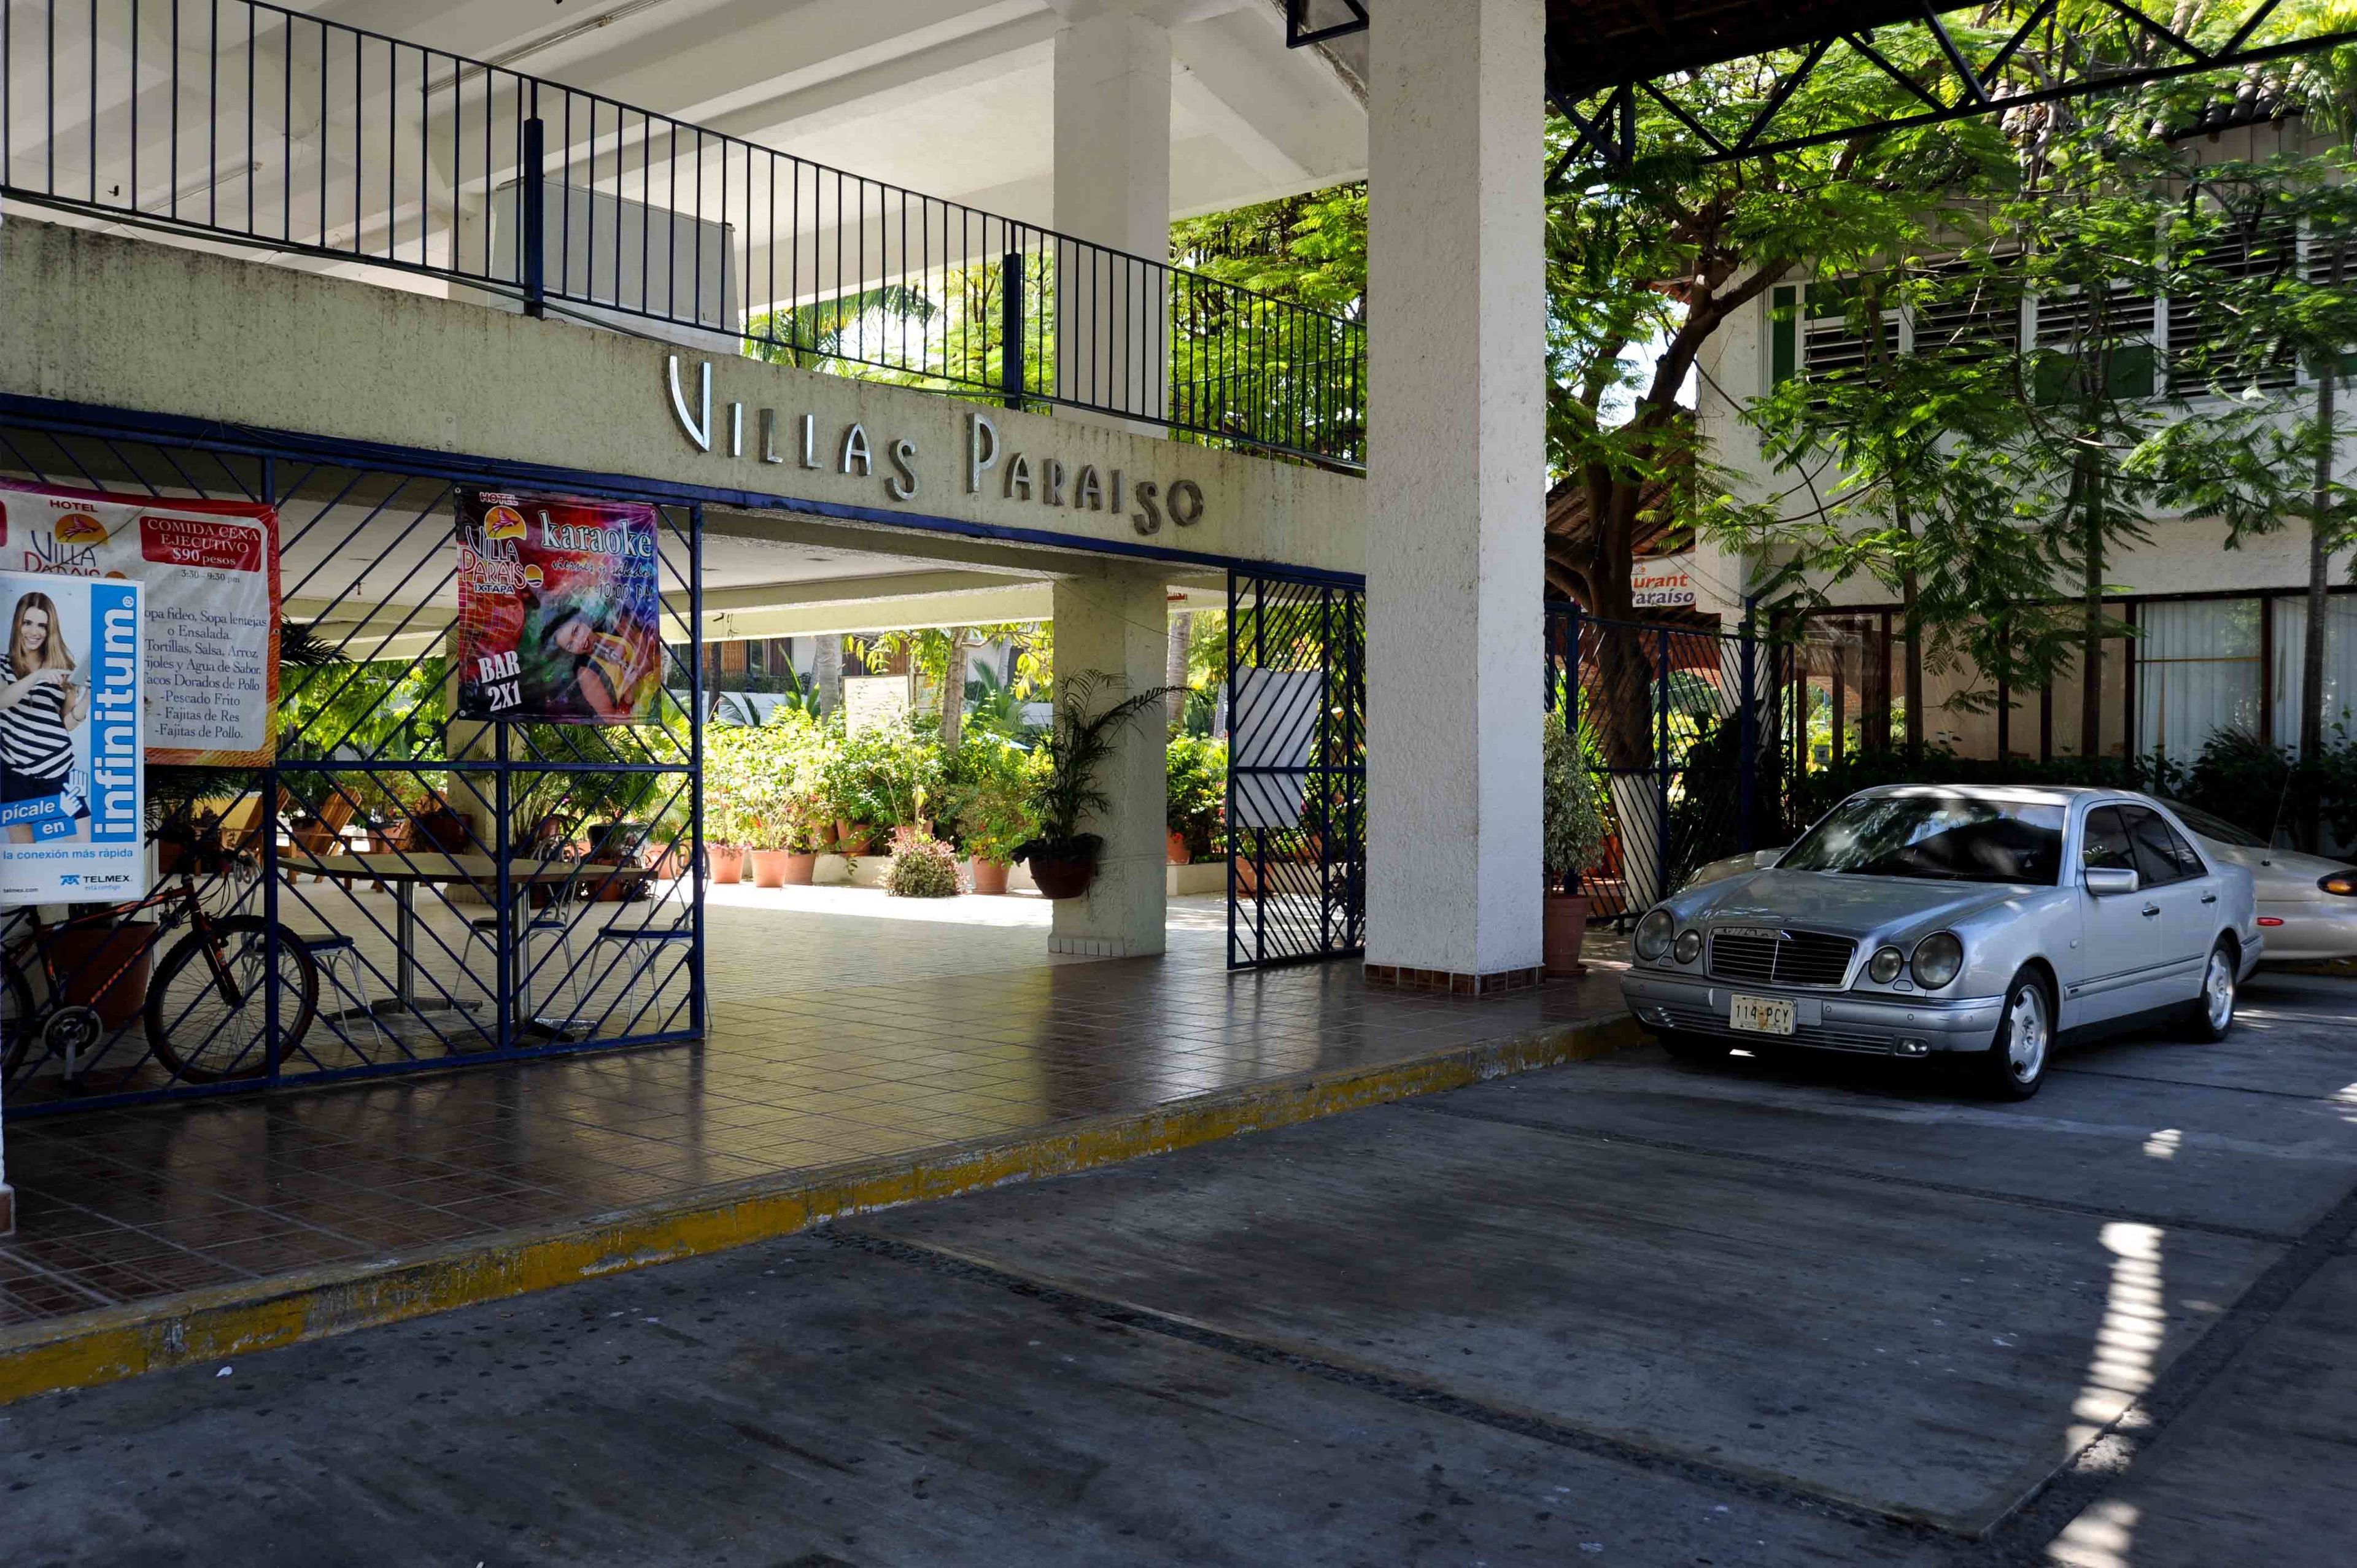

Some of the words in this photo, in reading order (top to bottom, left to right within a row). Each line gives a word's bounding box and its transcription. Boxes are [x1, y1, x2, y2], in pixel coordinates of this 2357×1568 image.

[668, 355, 919, 501] VILLAS
[967, 412, 1204, 536] PARAISO
[49, 499, 99, 513] HOTEL
[479, 492, 519, 506] HOTEL
[147, 519, 215, 536] COMIDA
[219, 527, 260, 541] CENA
[538, 510, 653, 558] karaoke
[31, 530, 96, 568] VILLA
[161, 533, 249, 553] EJECUTIVO
[465, 525, 519, 562] VILLA
[172, 547, 199, 562] $90
[203, 555, 236, 565] pesos
[181, 569, 199, 578] 3:30
[207, 572, 225, 581] 9:30
[1633, 574, 1689, 589] urant
[474, 584, 515, 595] IXTAPA
[144, 610, 164, 622] opa
[167, 607, 197, 622] fideo,
[200, 610, 227, 626] Sopa
[230, 612, 267, 628] lentejas
[179, 625, 233, 640] Ensalada.
[145, 639, 192, 655] Tortillas,
[144, 655, 174, 671] ijoles
[177, 661, 184, 671] y
[187, 658, 215, 674] Agua
[217, 660, 230, 673] de
[478, 651, 522, 684] BAR
[174, 674, 220, 688] Dorados
[222, 677, 235, 689] de
[238, 678, 260, 691] Pollo
[214, 693, 241, 706] Frito
[487, 680, 522, 711] 2X1
[165, 706, 201, 722] Fajitas
[204, 708, 217, 722] de
[221, 709, 240, 722] Res
[198, 725, 212, 738] de
[2, 800, 55, 824] pícale
[42, 821, 65, 835] en
[3, 850, 13, 860] la
[17, 849, 69, 860] conexión
[72, 849, 96, 859] más
[99, 848, 133, 860] rápida
[82, 875, 130, 884] TELMEX
